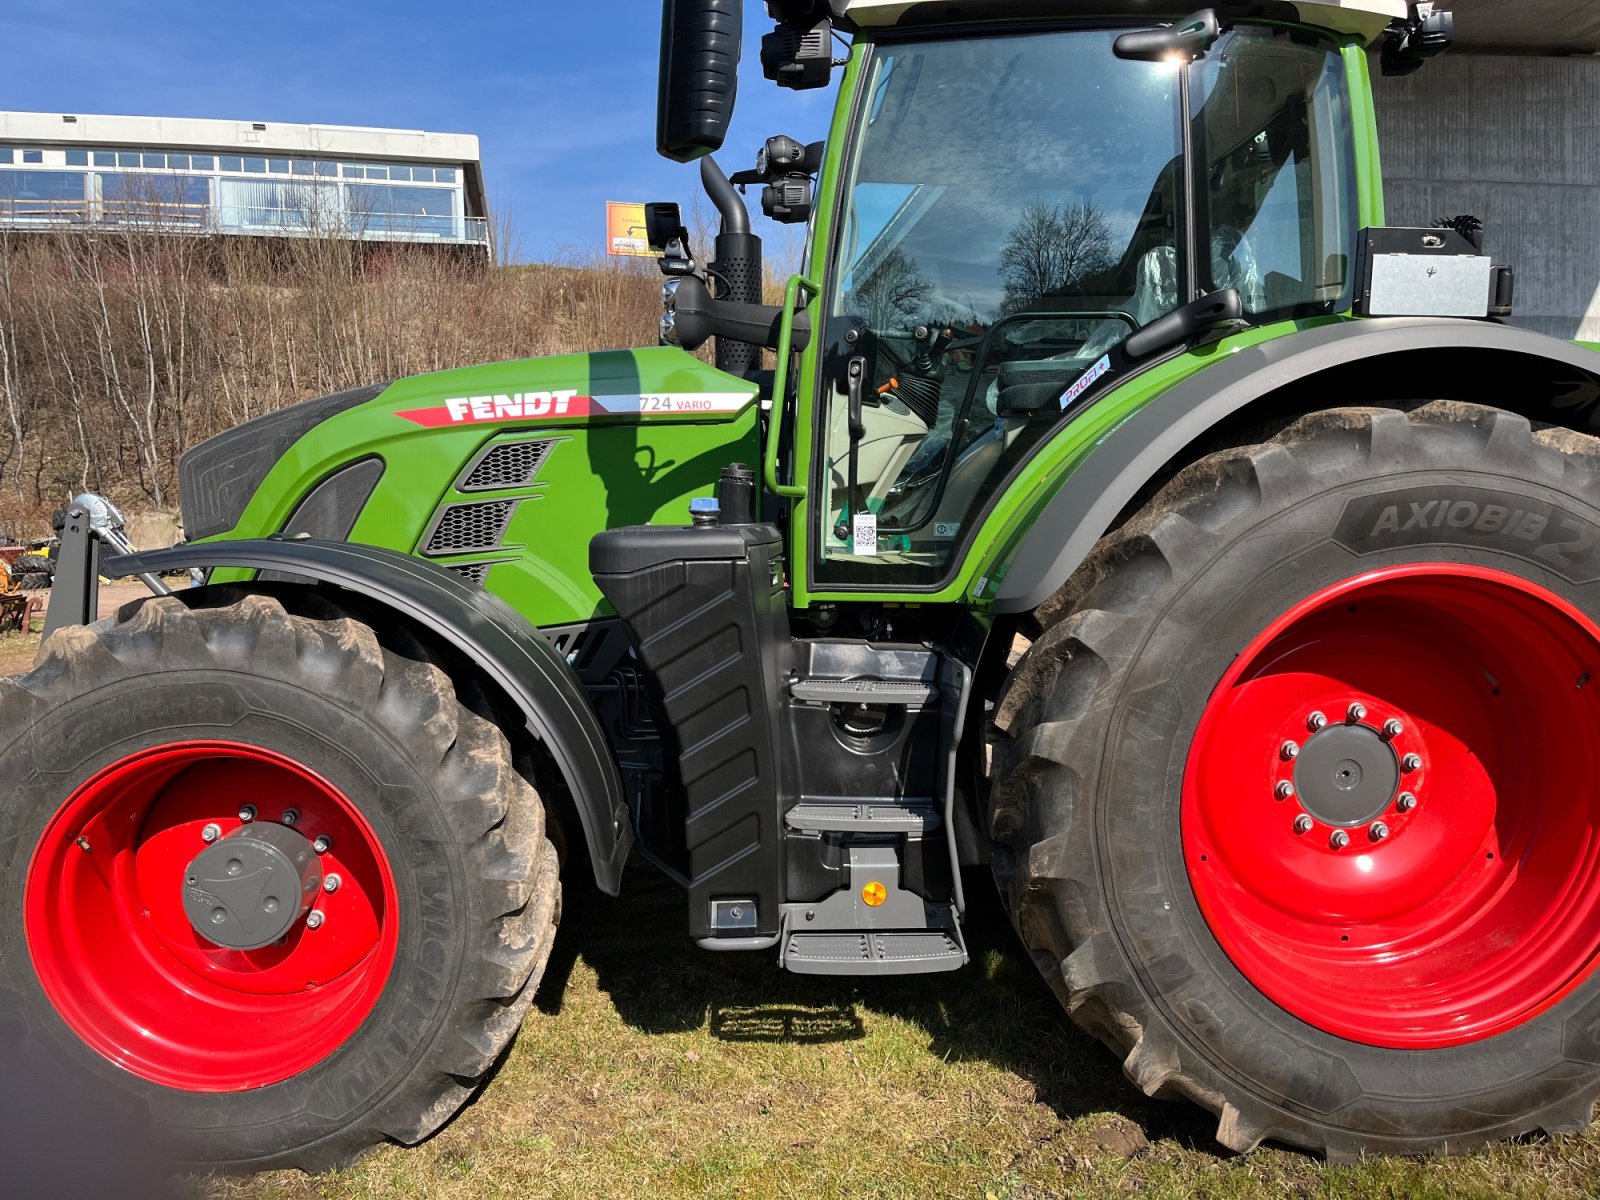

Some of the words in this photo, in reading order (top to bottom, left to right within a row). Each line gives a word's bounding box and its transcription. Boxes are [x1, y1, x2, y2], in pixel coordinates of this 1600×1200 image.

[444, 389, 578, 422] FENDT
[640, 397, 672, 411] 724
[676, 400, 712, 410] VARIO
[1370, 499, 1548, 541] AXIOBIB
[1532, 517, 1594, 566] 2
